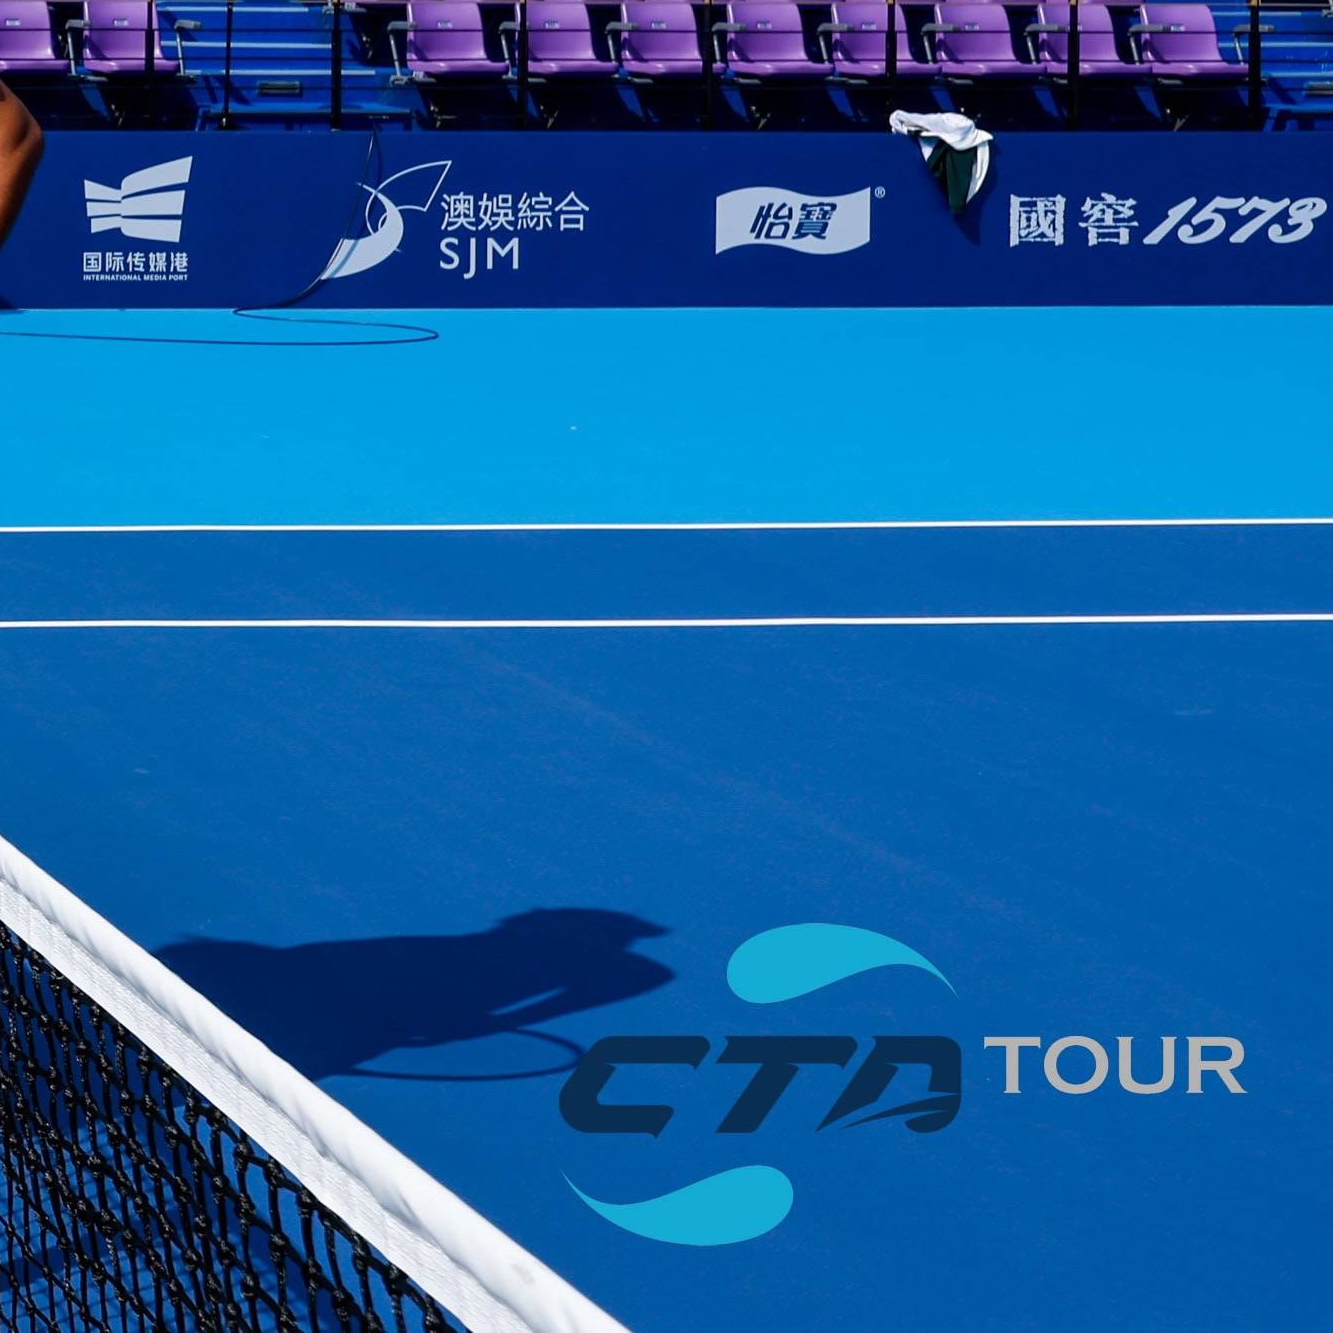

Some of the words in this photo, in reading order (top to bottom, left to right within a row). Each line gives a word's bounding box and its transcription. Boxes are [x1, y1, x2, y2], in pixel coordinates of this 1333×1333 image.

[440, 191, 590, 232] 澳娛綜合
[749, 202, 838, 240] 怡寶
[1009, 192, 1139, 248] 國窖
[1142, 195, 1328, 245] 1573
[83, 252, 189, 273] 国际传媒港
[83, 273, 142, 282] INTERNATIONAL
[143, 273, 167, 282] MEDIA
[168, 273, 188, 282] PORT
[439, 237, 519, 280] SJM
